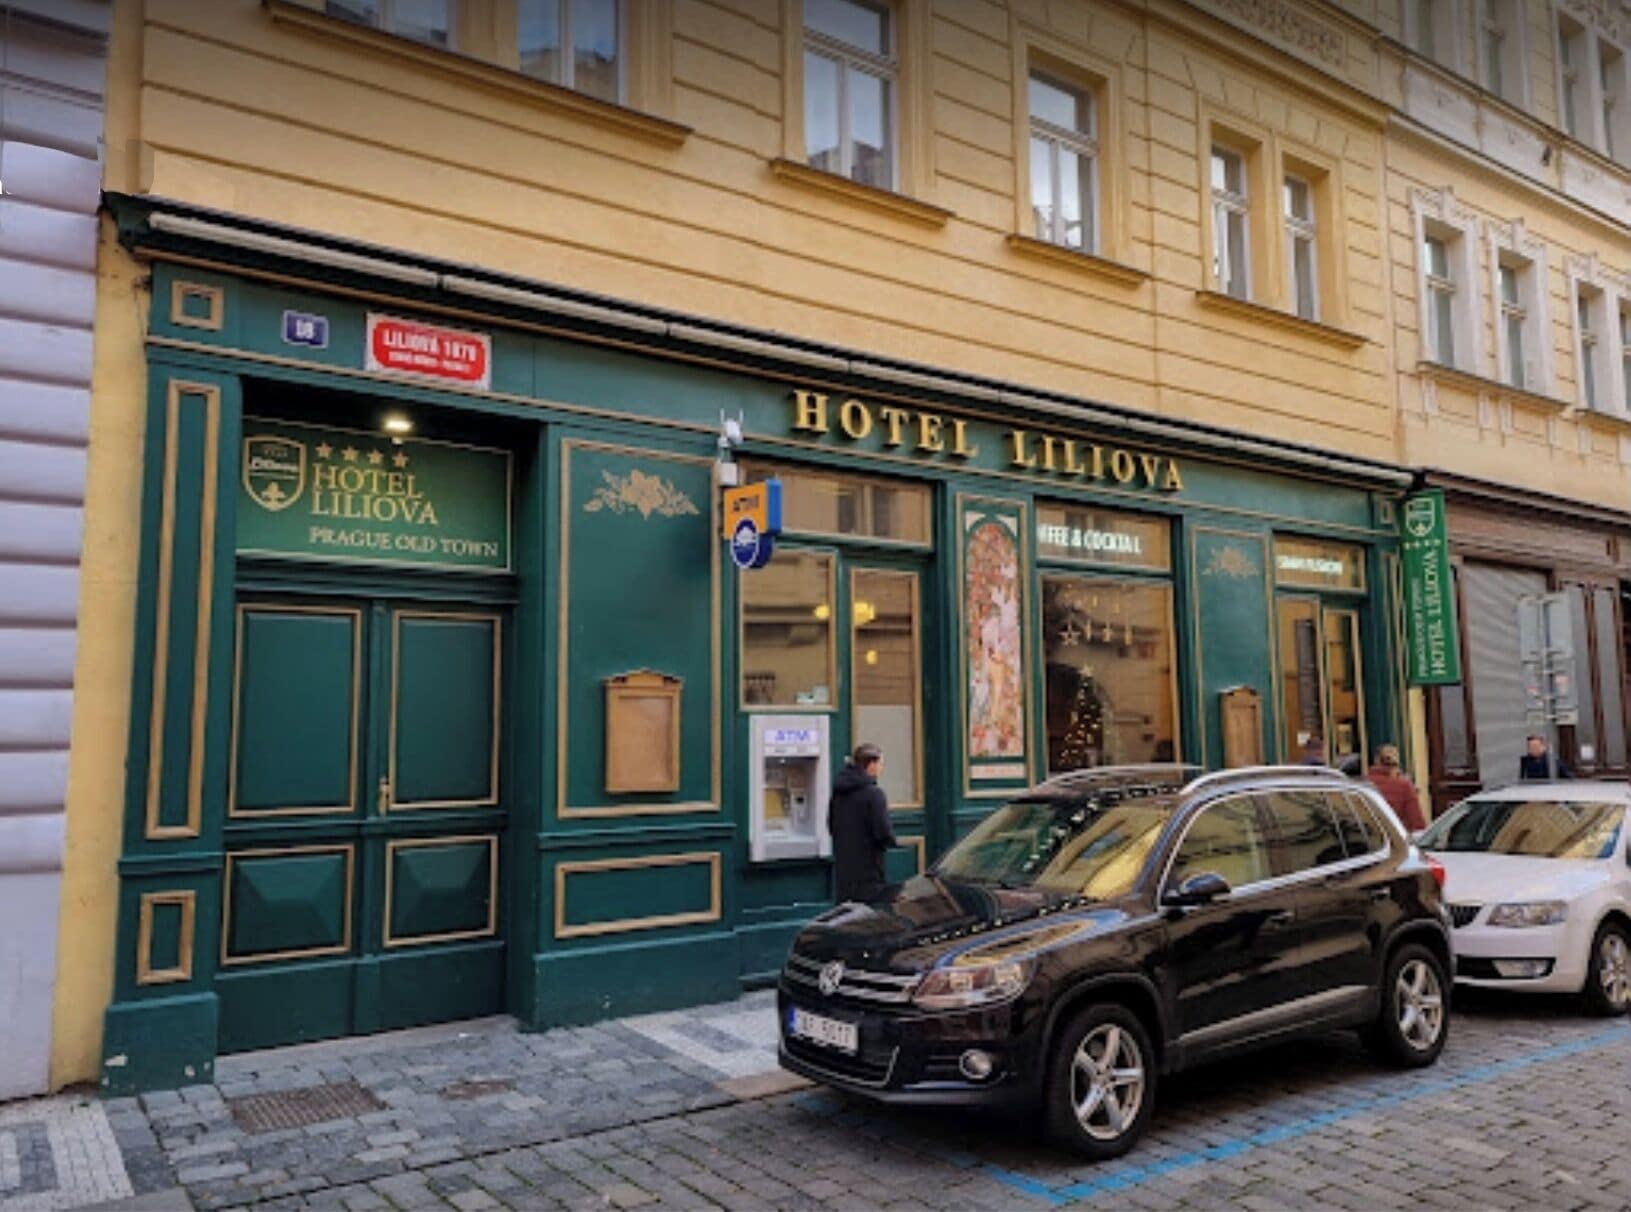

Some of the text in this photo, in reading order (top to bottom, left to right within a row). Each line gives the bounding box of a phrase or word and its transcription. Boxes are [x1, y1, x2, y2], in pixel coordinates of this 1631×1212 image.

[793, 389, 1184, 490] HOTEL LILIOVA
[312, 463, 424, 499] HOTEL
[310, 490, 438, 525] LILIOVA
[309, 526, 499, 558] PRAGUE OLD TOWN
[1422, 550, 1447, 676] HOTEL LILIOVA
[773, 728, 811, 742] ATM
